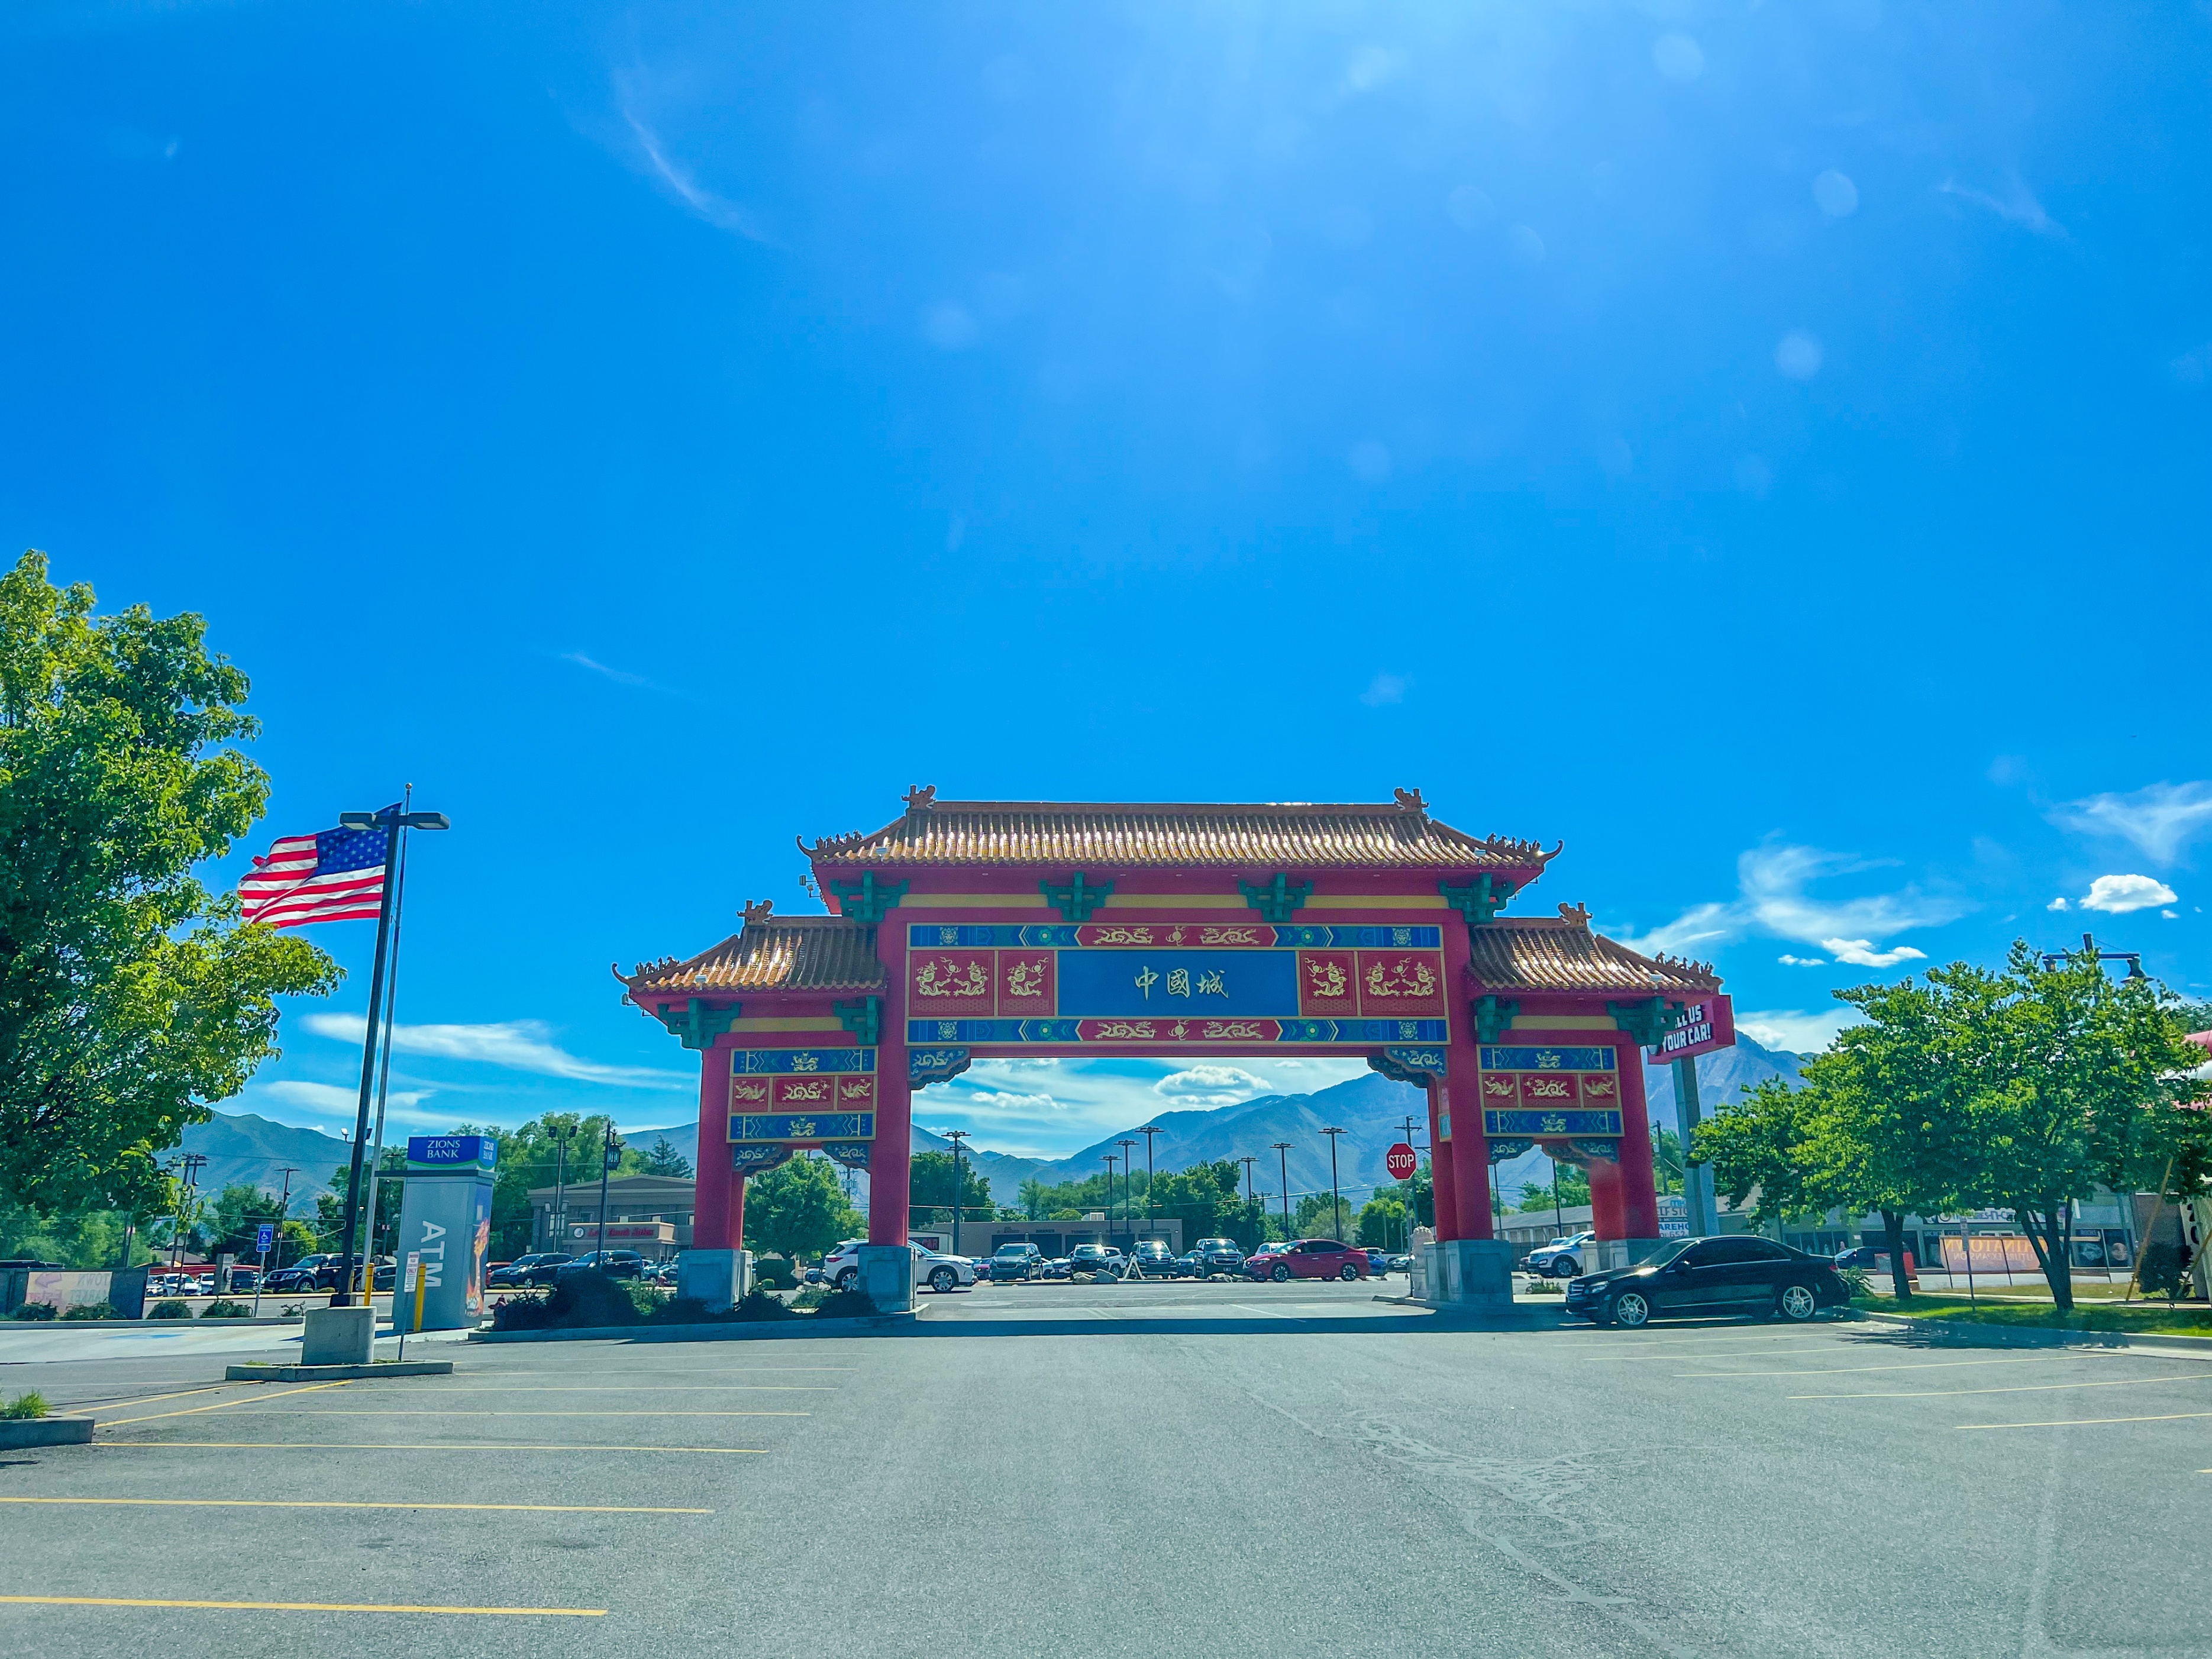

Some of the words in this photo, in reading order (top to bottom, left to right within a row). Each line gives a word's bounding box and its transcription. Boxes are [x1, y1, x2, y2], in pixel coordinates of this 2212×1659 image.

[1134, 965, 1229, 1001] 中國城
[1688, 1004, 1702, 1024] US
[1662, 1030, 1687, 1053] YOUR
[1687, 1022, 1712, 1045] CAR!
[427, 1140, 460, 1148] ZIONS
[427, 1149, 459, 1158] BANK
[1388, 1154, 1415, 1169] STOP
[420, 1220, 447, 1287] ATM
